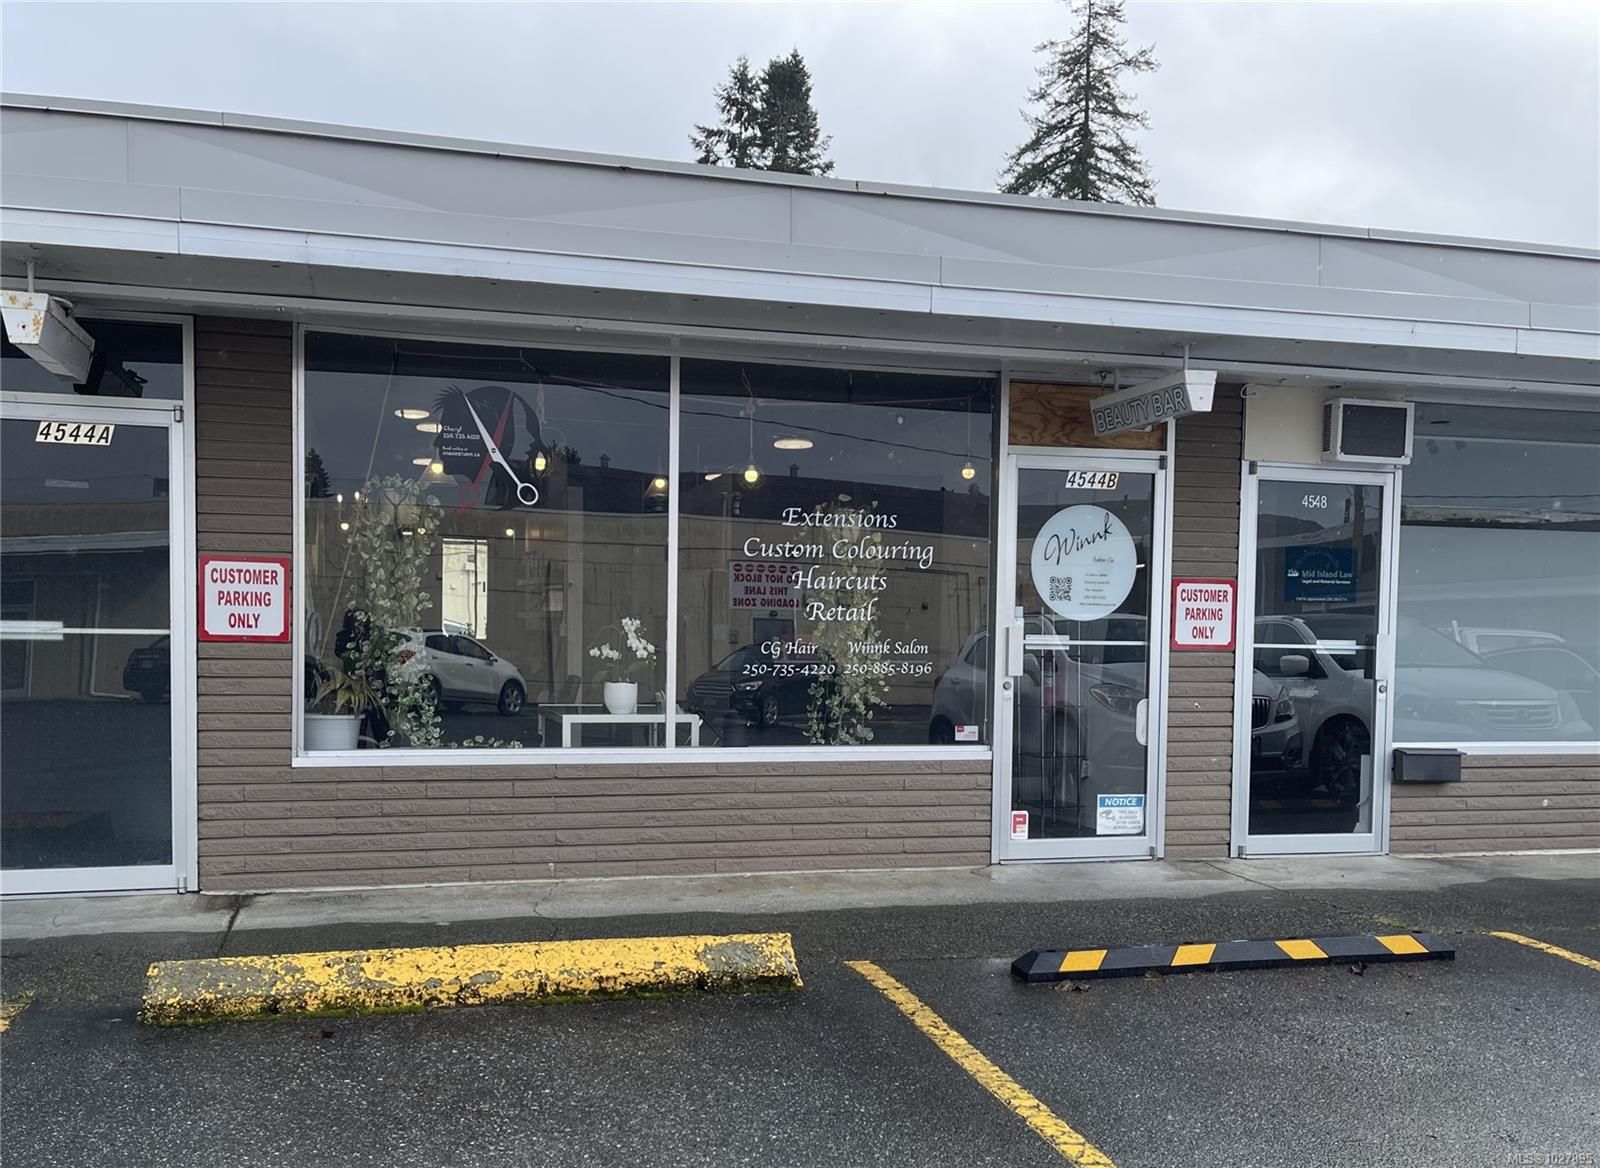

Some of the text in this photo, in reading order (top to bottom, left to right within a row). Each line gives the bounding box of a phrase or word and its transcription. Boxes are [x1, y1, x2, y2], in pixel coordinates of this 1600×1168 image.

[1095, 387, 1186, 432] BEAUTY BAR
[39, 422, 110, 444] 4544A
[1067, 472, 1118, 489] 4544B
[1302, 495, 1328, 509] 4548
[782, 507, 898, 529] Extensions
[743, 536, 934, 569] Custom Colouring
[210, 567, 279, 586] CUSTOMER
[792, 565, 888, 590] Haircuts
[1301, 570, 1316, 578] Mid
[1317, 570, 1338, 578] Island
[217, 590, 272, 608] PARKING
[1180, 588, 1229, 603] CUSTOMER
[806, 598, 878, 621] Retail
[1184, 607, 1223, 621] PARKING
[228, 613, 261, 629] ONLY
[1191, 626, 1215, 640] ONLY
[760, 638, 819, 659] CG Hair
[894, 638, 929, 655] Salon
[742, 663, 835, 676] 250-735-4220
[844, 661, 932, 676] 250-885-8196
[1104, 797, 1138, 806] NOTICE
